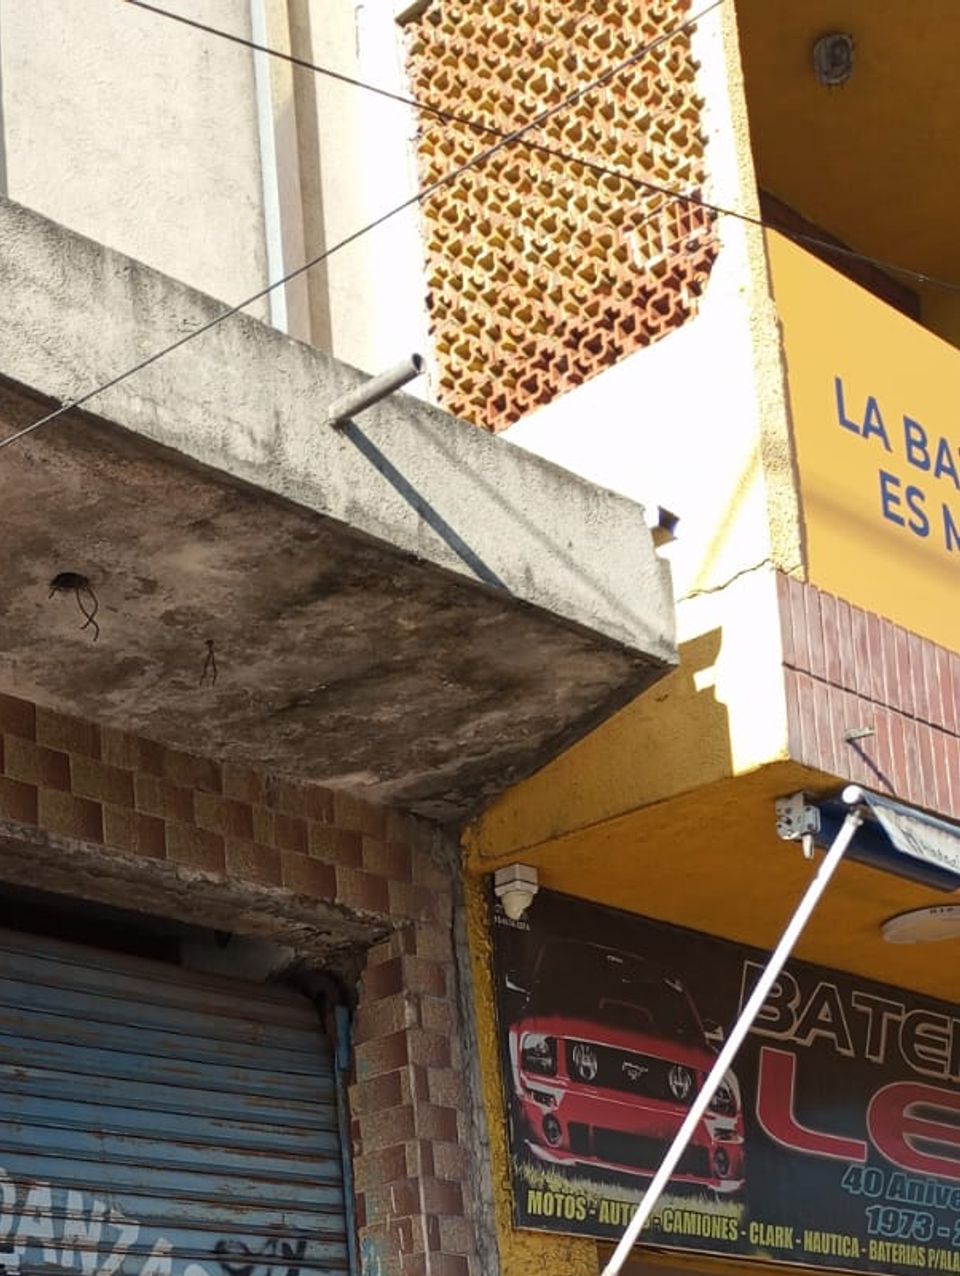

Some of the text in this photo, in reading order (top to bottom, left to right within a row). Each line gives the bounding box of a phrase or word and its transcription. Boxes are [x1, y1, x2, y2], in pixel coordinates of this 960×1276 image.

[835, 375, 960, 491] LA BA
[878, 468, 930, 538] ES
[841, 1164, 885, 1198] 40
[527, 1189, 587, 1222] MOTOS
[598, 1199, 650, 1230] AUT
[663, 1208, 738, 1241] CAMIONES
[749, 1221, 794, 1249] CLARK
[803, 1229, 860, 1258] NAUTICA
[868, 1239, 927, 1268] BATERIAS
[865, 1204, 934, 1242] 1973
